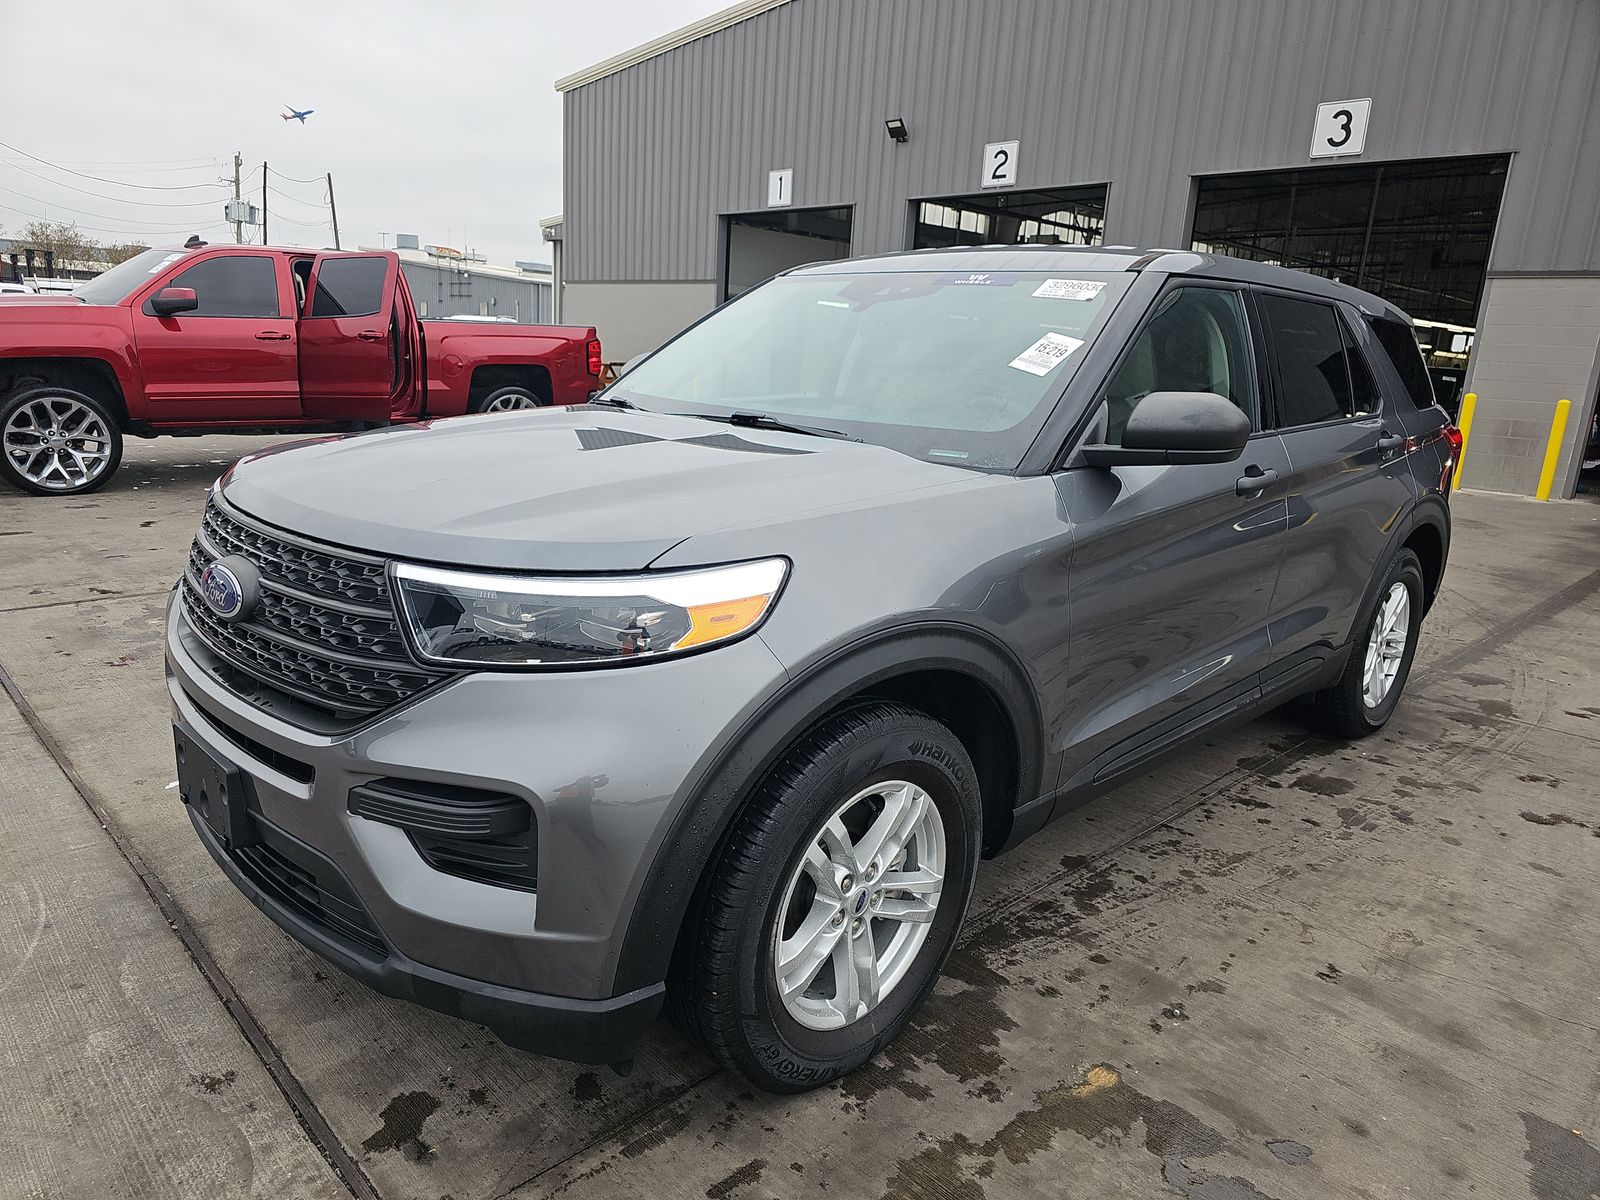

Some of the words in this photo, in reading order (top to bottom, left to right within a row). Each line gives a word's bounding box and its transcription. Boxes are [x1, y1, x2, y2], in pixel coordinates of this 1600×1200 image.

[1326, 109, 1353, 148] 3
[991, 149, 1009, 180] 2
[778, 175, 783, 201] 1
[206, 573, 229, 607] Ford
